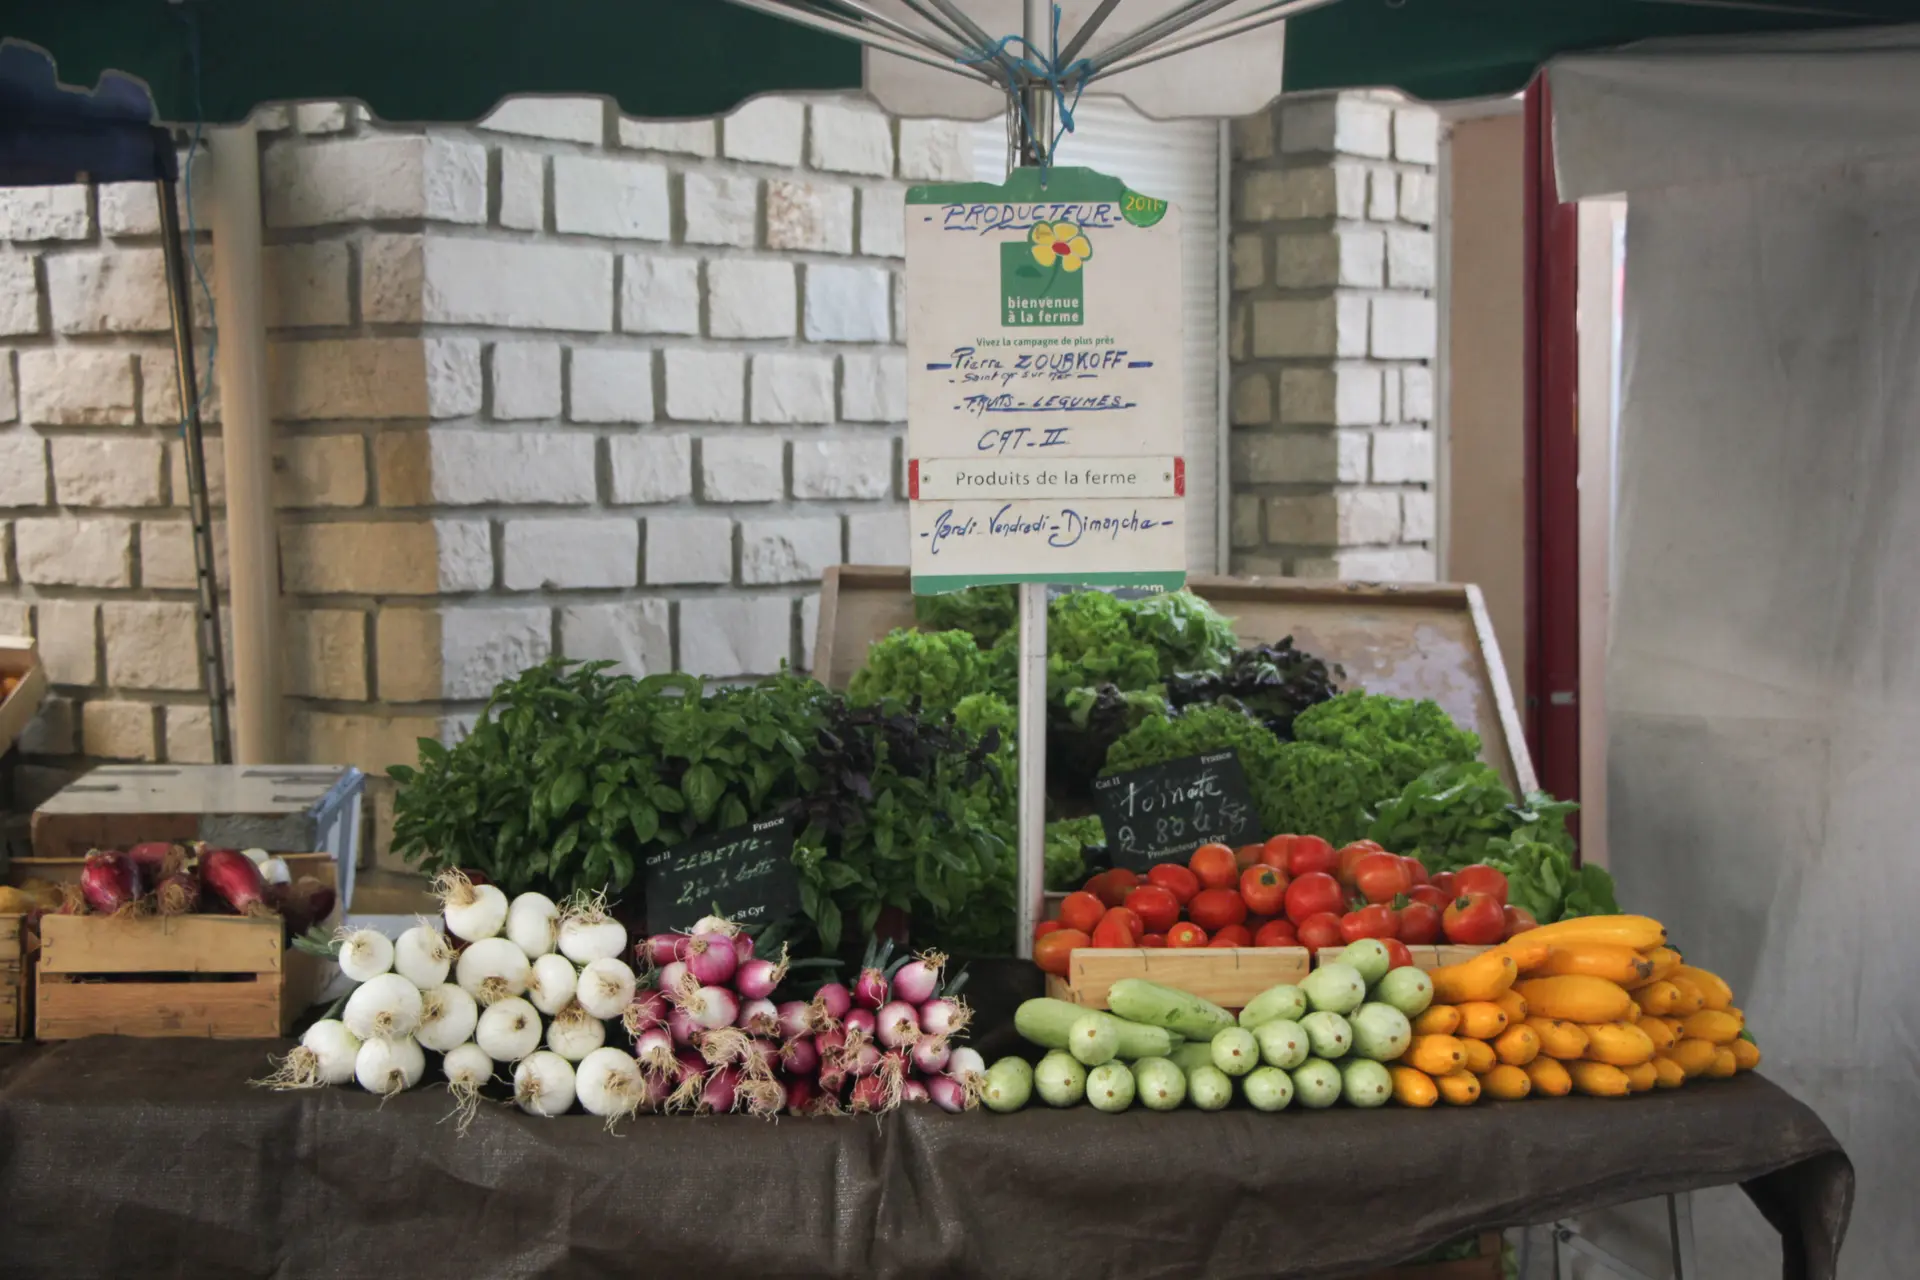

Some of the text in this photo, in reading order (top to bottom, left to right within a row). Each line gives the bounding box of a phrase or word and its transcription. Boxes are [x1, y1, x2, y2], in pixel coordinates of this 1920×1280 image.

[942, 204, 1113, 226] PRODUCTEUR
[1008, 296, 1079, 309] bienvenue
[1007, 310, 1079, 323] à la ferme
[976, 336, 1115, 349] Vivez la campagne de plus près
[1015, 350, 1127, 373] ZOUBKOFF
[1033, 395, 1121, 409] LEGUMES
[956, 470, 1137, 486] Produits de la ferme
[1200, 751, 1233, 764] France
[752, 816, 785, 833] France
[737, 904, 767, 920] St Cyr
